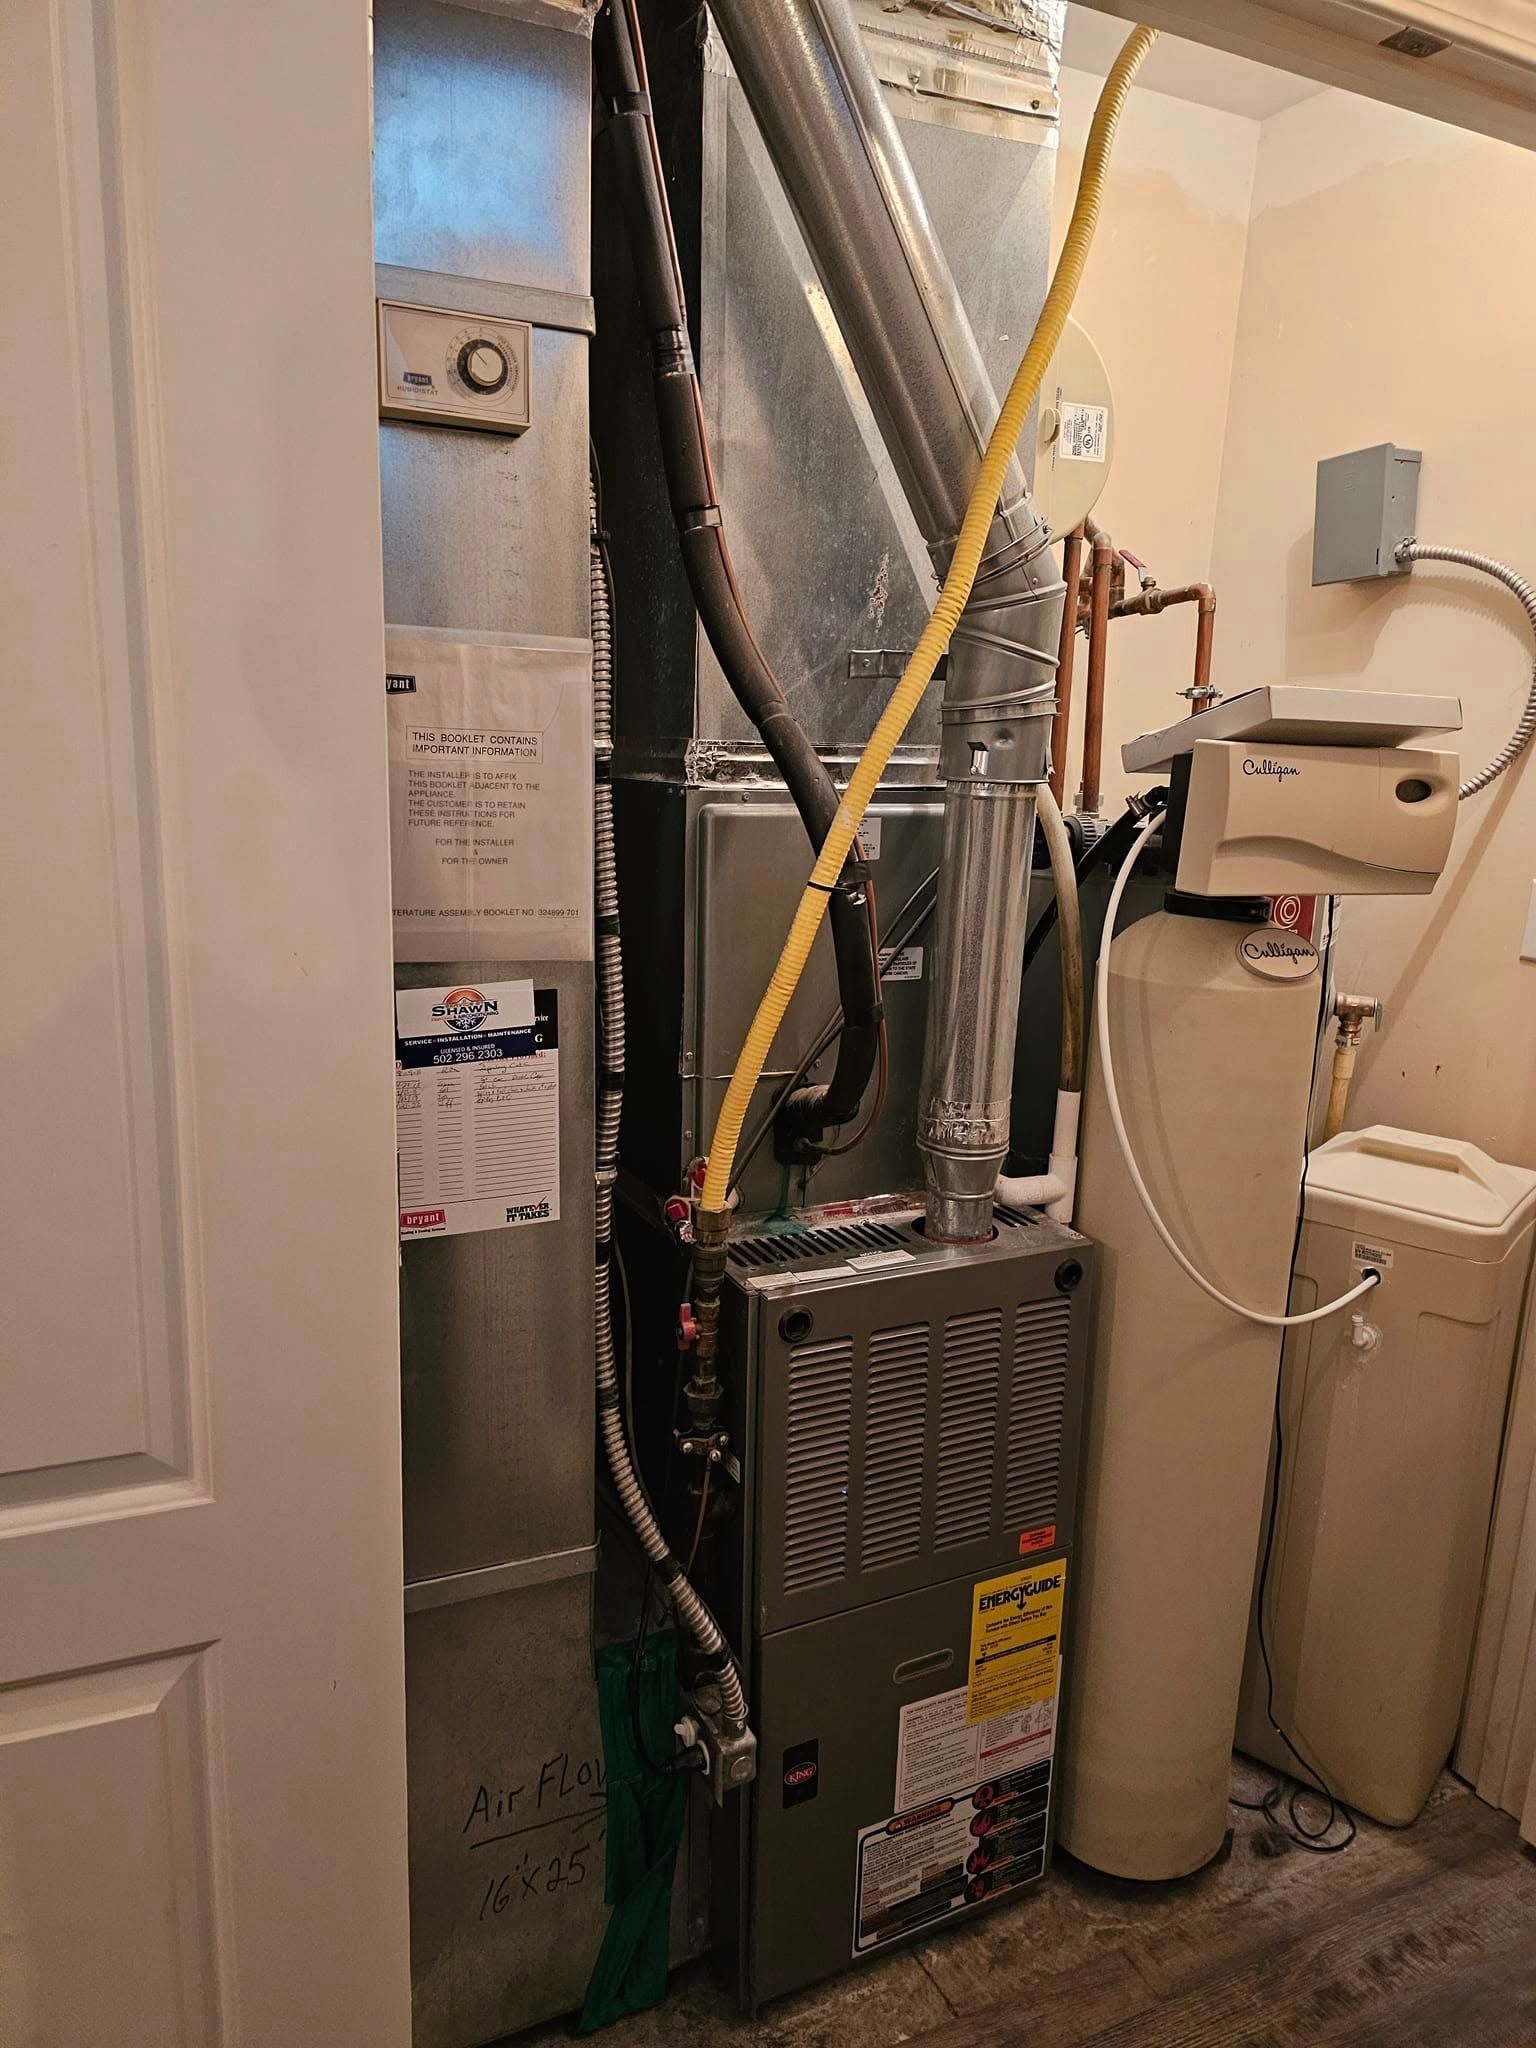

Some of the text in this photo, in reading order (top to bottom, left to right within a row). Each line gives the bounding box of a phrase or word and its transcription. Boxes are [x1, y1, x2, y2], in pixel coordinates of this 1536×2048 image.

[397, 385, 438, 396] HUMIDISTAT
[412, 732, 538, 746] THIS BOOKLET CONTAINS
[412, 745, 537, 757] IMPORTANT INFORMATION
[408, 770, 425, 778] THE
[473, 772, 481, 780] S
[495, 773, 517, 781] AFFIX
[1242, 759, 1301, 783] Culligan
[408, 780, 541, 791] THIS BOOKLET ADJACENT TO THE
[408, 800, 425, 808] THE
[427, 800, 471, 809] CUSTOMER
[485, 801, 496, 809] TO
[497, 802, 526, 810] RETAIN
[408, 809, 515, 819] THESE INSTRUCTIONS FOR
[408, 819, 441, 827] FUTURE
[435, 839, 514, 848] FOR THE INSTALLER
[441, 857, 508, 865] FOR THE OWNER
[439, 908, 482, 917] ASSEMBLY
[483, 908, 520, 916] BOOKLET
[1244, 941, 1315, 965] Culligan
[431, 1000, 498, 1017] SHAWN
[404, 1028, 532, 1047] SERVICE INSTALLATION MAINTENANCE
[440, 1046, 466, 1055] LICENSED
[471, 1043, 495, 1051] INSURED
[433, 1054, 453, 1065] 502
[455, 1052, 475, 1063] 296
[478, 1048, 503, 1060] 2303
[406, 1213, 440, 1225] bryant
[506, 1209, 550, 1223] IT TAKES
[978, 1574, 1062, 1612] ENERGYGUIDE
[789, 1766, 814, 1783] KING
[463, 1785, 526, 1834] Air
